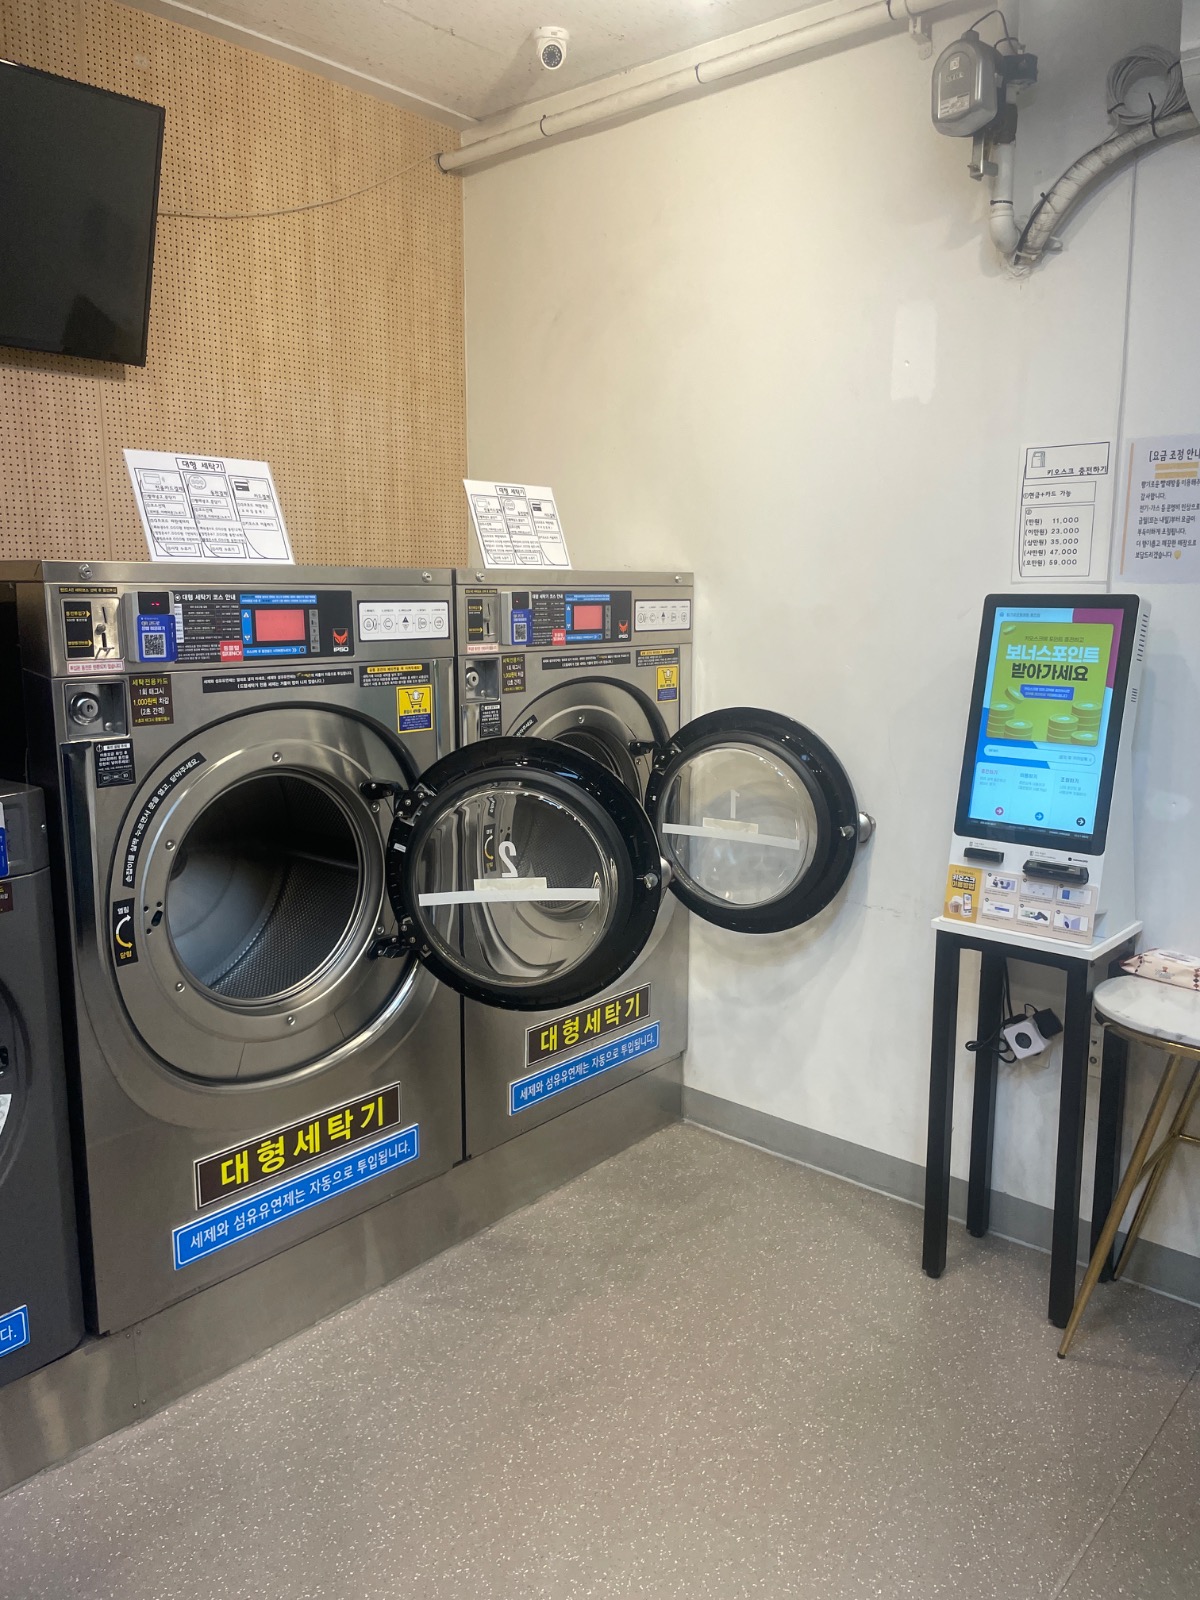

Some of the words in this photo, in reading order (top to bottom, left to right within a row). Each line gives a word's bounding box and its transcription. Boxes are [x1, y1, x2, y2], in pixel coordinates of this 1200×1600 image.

[1169, 448, 1184, 461] 조정
[182, 460, 197, 470] 대형
[201, 462, 224, 472] 세탁기
[1047, 468, 1074, 476] 키오스크
[195, 593, 211, 601] 세탁기
[225, 593, 236, 601] 안내
[1005, 643, 1100, 663] 보너스포인트
[1011, 662, 1089, 681] 받아가세요
[132, 677, 168, 686] 세탁전용카드
[139, 687, 148, 695] 1회
[148, 686, 165, 695] 태그시
[1060, 776, 1080, 784] 조회하기
[135, 809, 152, 837] 누르면서
[147, 796, 160, 810] 문을
[540, 992, 641, 1052] 대형세탁기
[519, 1083, 544, 1101] 세제와
[545, 1061, 590, 1091] 섬유유연제는
[591, 1049, 619, 1069] 자동으로
[620, 1032, 656, 1057] 투입됩니다.
[220, 1096, 384, 1187] 대형세탁기
[190, 1221, 230, 1249] 세제와
[233, 1189, 307, 1232] 섬유유연제는
[309, 1165, 354, 1195] 자동으로
[356, 1140, 411, 1175] 투입됩니다.
